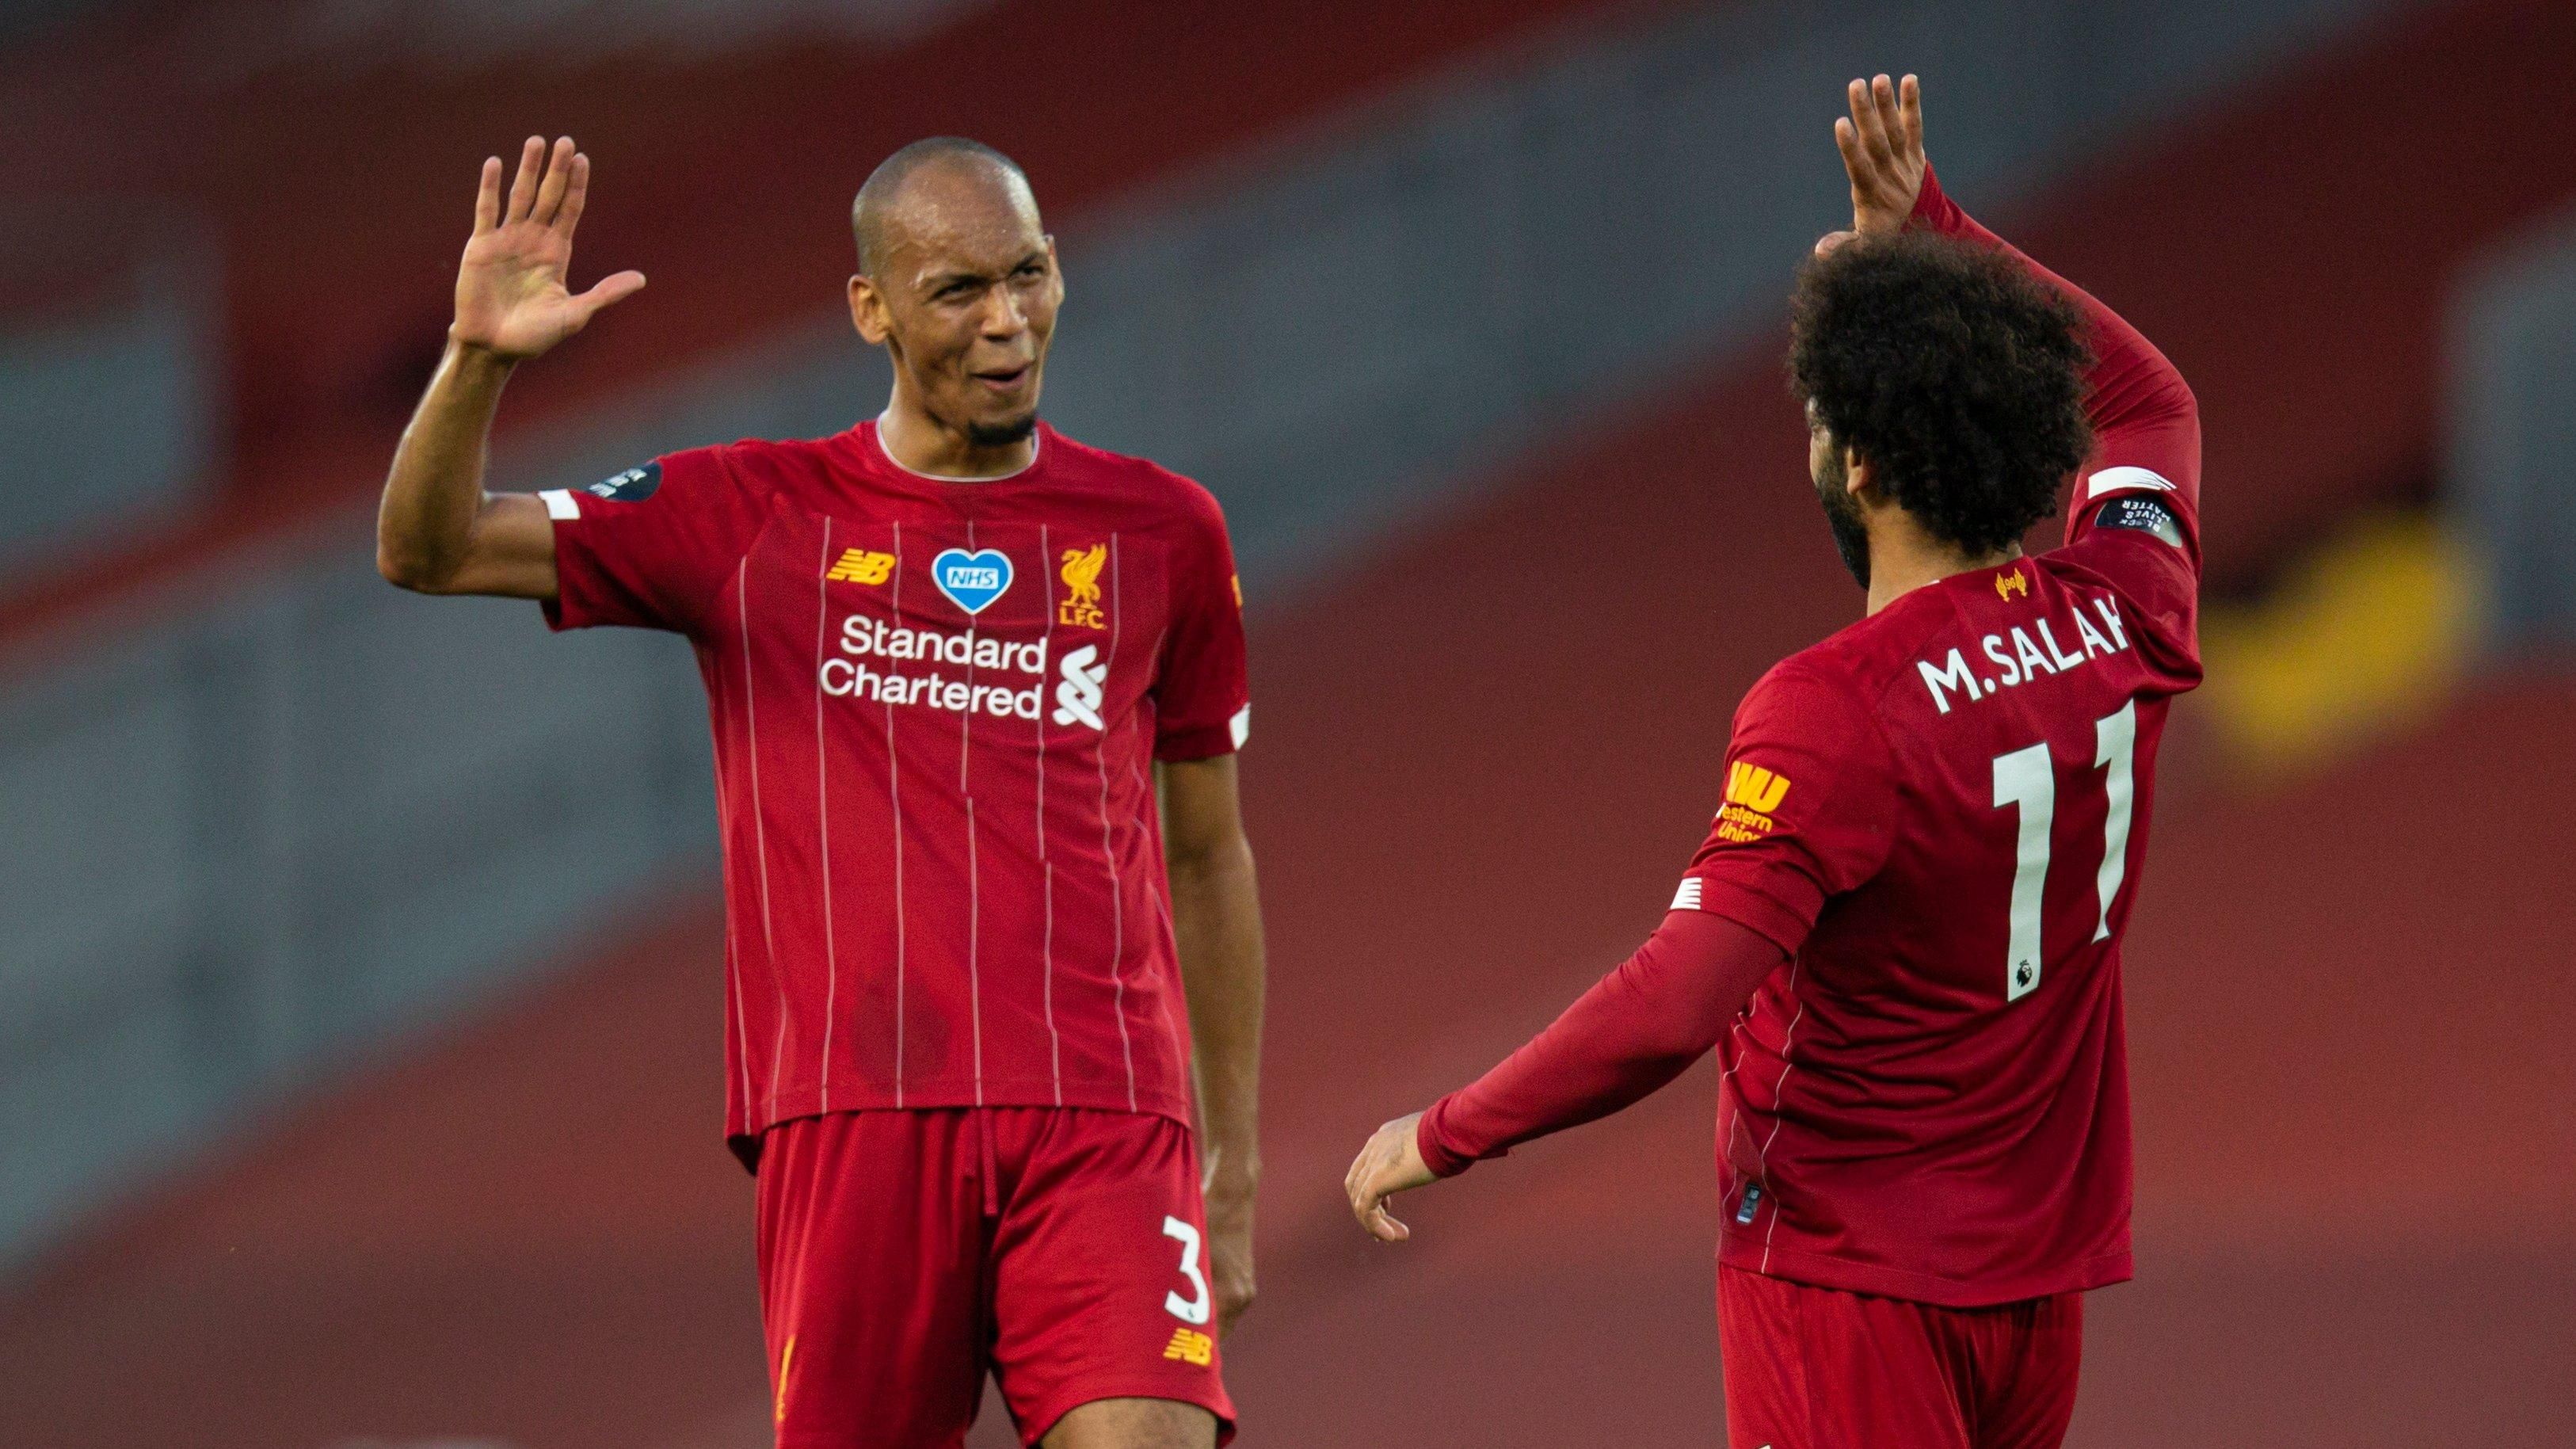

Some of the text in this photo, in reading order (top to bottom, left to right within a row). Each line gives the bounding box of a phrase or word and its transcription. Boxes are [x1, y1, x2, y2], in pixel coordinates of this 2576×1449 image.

[2125, 510, 2162, 524] LIVES
[951, 569, 996, 587] NHS
[840, 615, 1048, 674] Standard
[820, 658, 1043, 720] Chartered
[1726, 760, 1792, 814] WU
[1716, 803, 1773, 833] estern
[1993, 697, 2136, 1002] 11
[1163, 1215, 1210, 1325] 3
